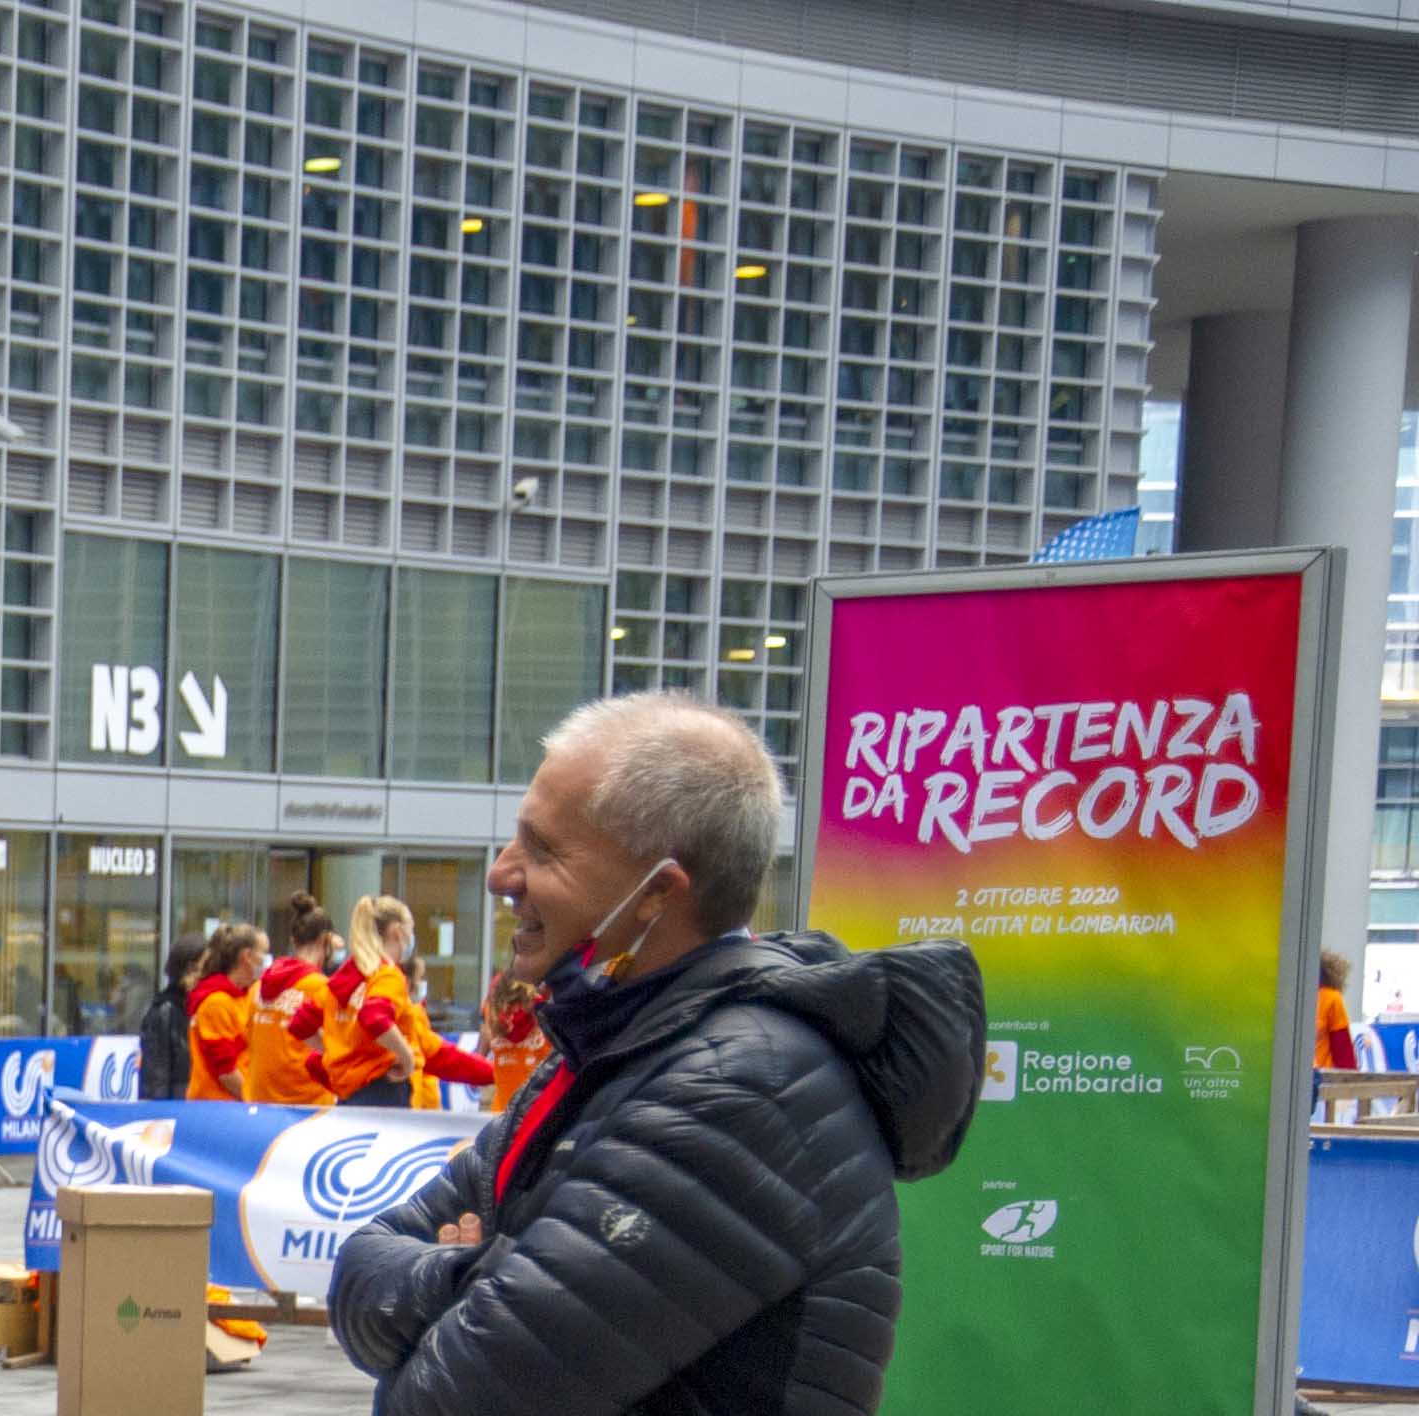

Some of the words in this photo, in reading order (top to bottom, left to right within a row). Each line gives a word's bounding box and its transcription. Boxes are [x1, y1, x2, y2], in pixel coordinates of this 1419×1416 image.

[90, 664, 160, 755] N3
[845, 693, 1261, 777] RIPARTENZA
[843, 774, 908, 824] DA
[917, 763, 1260, 854] RECORD
[89, 846, 144, 875] NUCLEO
[145, 847, 156, 875] 3
[955, 890, 968, 907] 2
[973, 887, 1064, 907] OTTOBRE
[1069, 886, 1120, 905] 2020
[898, 917, 965, 936] PIAZZA
[1030, 916, 1052, 934] DI
[1057, 913, 1175, 935] LOMBARDIA
[1023, 1050, 1132, 1075] Regione
[1021, 1073, 1163, 1094] Lombardia
[1, 1119, 41, 1140] MILAN
